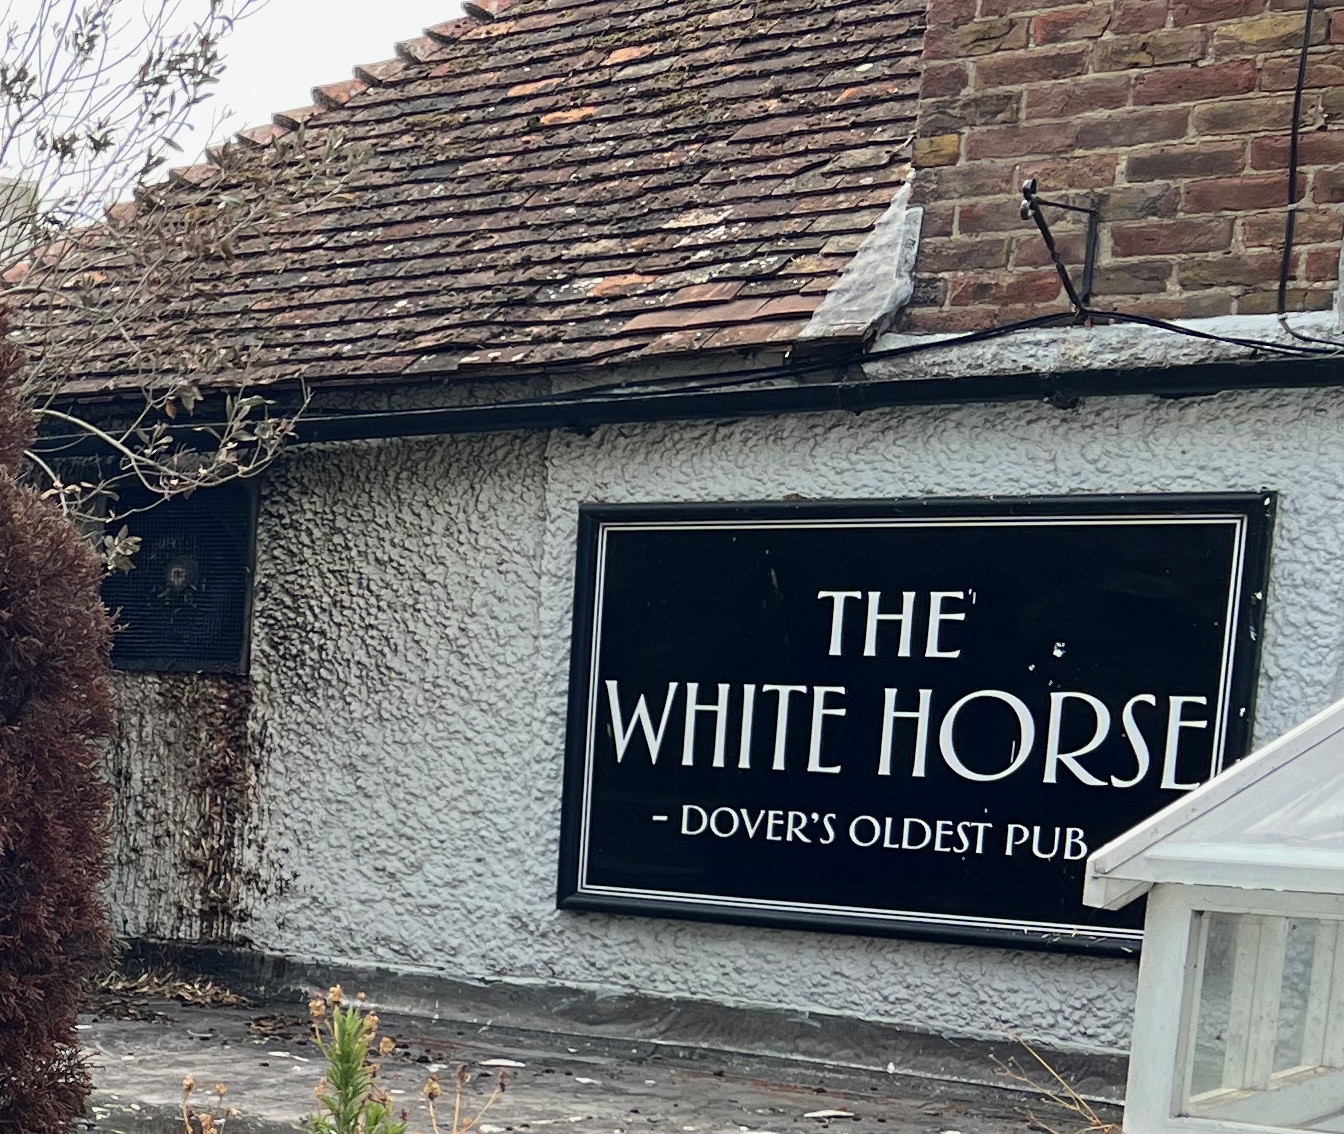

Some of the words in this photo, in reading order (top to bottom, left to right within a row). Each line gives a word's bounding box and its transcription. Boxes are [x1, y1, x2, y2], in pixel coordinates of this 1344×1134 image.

[817, 590, 966, 659] THE
[604, 679, 847, 774] WHITE
[877, 687, 1208, 790] HORSE
[680, 804, 837, 845] DOVER'S
[848, 815, 994, 854] OLDEST
[1005, 823, 1088, 860] PUB
